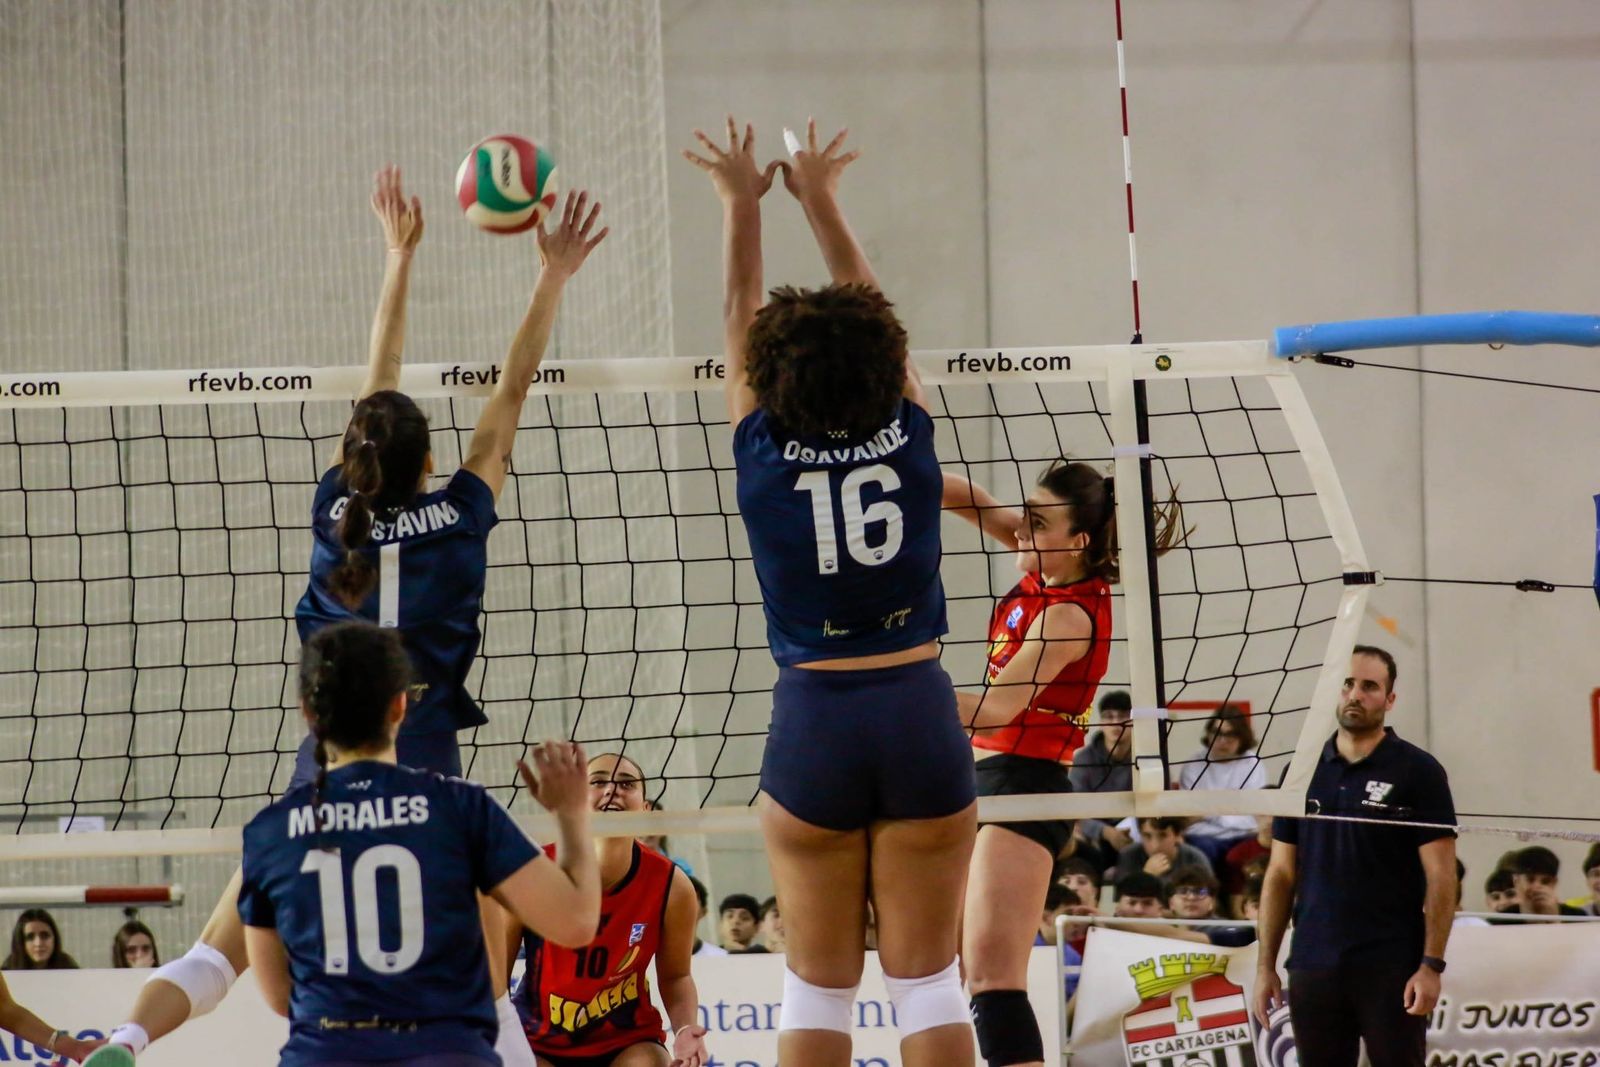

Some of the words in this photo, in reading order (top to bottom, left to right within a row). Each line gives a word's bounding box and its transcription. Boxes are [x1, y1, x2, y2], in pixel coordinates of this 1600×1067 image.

[946, 352, 1071, 373] rfevb.com
[188, 371, 312, 392] rfevb.com
[793, 463, 904, 575] 16
[379, 541, 400, 629] 1
[288, 794, 429, 839] MORALES
[300, 843, 425, 977] 10
[575, 946, 609, 979] 10
[1463, 1001, 1596, 1030] JUNTOS
[1131, 1045, 1150, 1059] FC
[1154, 1027, 1248, 1055] CARTAGENA
